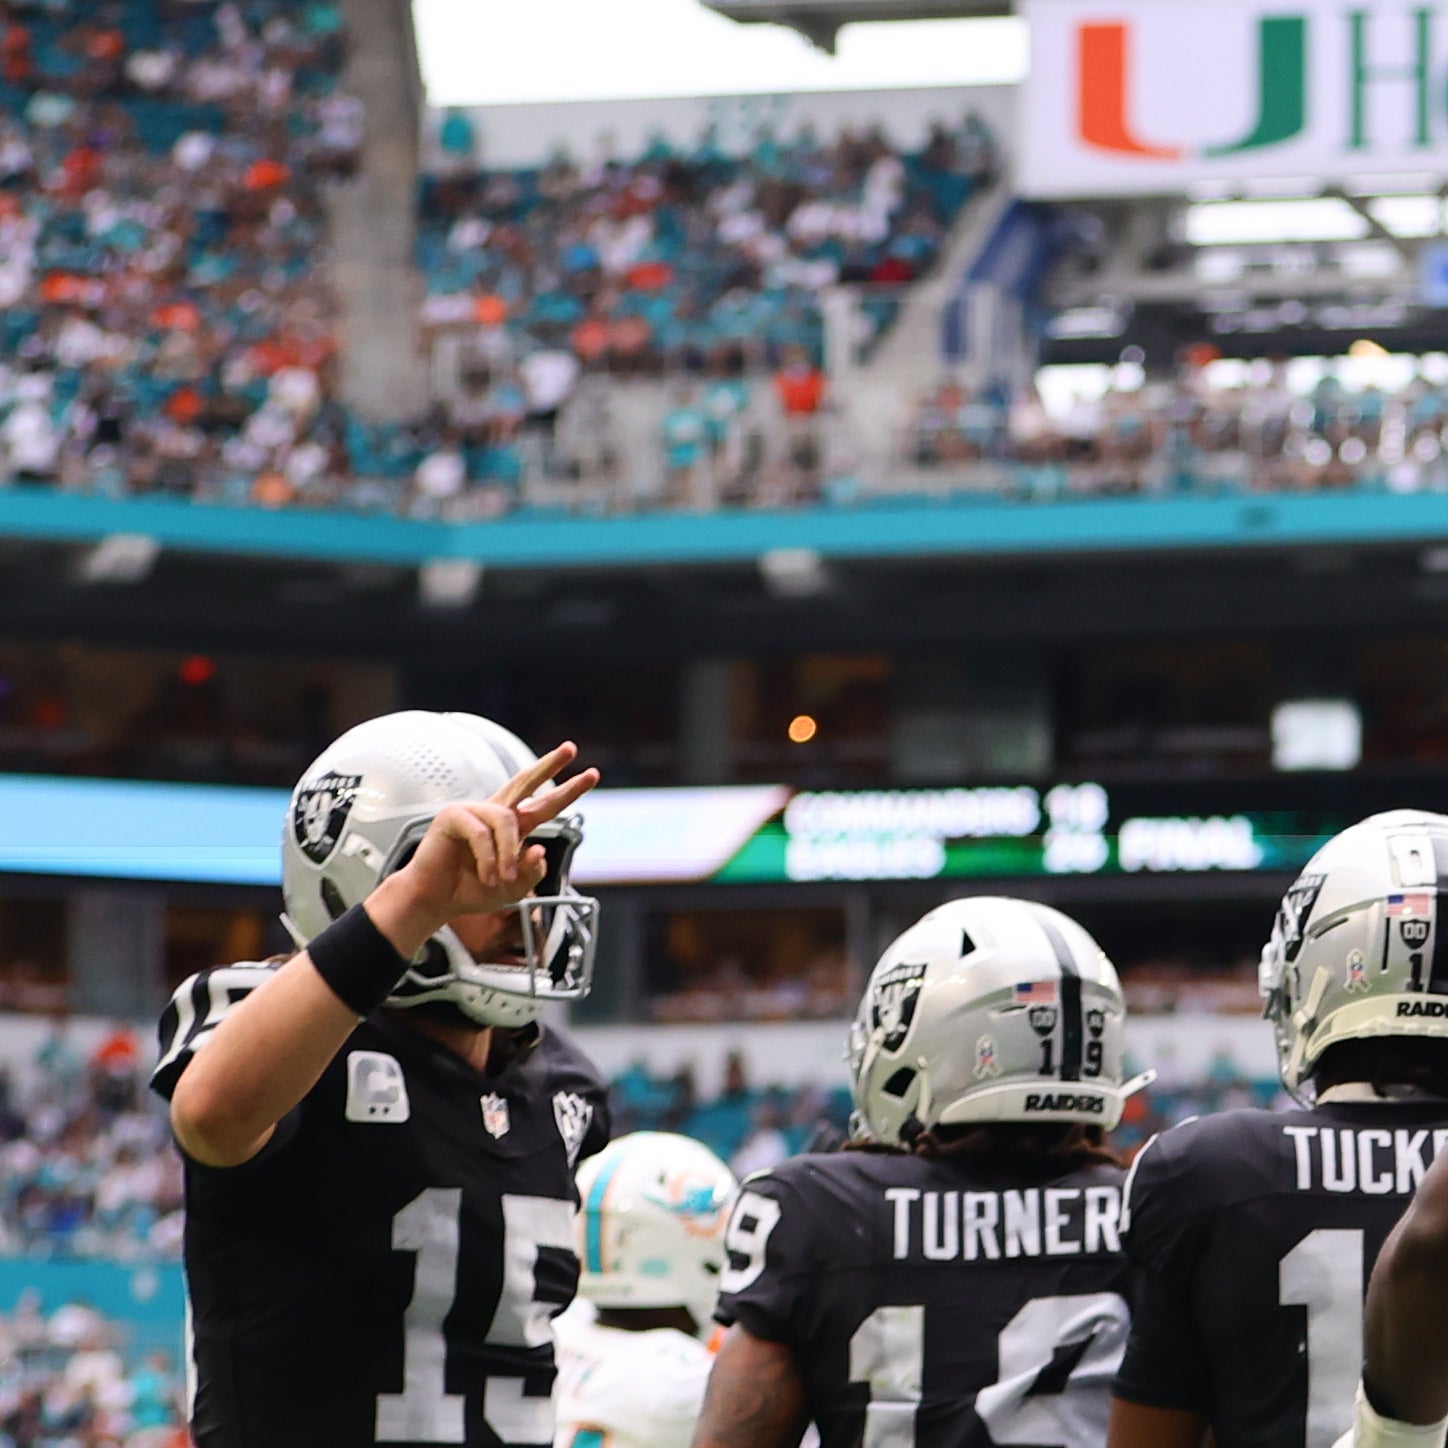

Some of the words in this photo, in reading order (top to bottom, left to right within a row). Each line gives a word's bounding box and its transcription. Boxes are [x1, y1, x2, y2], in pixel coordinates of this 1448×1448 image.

[1024, 1094, 1104, 1114] RAIDERS
[884, 1186, 1123, 1261] TURNER
[374, 1187, 580, 1445] 15
